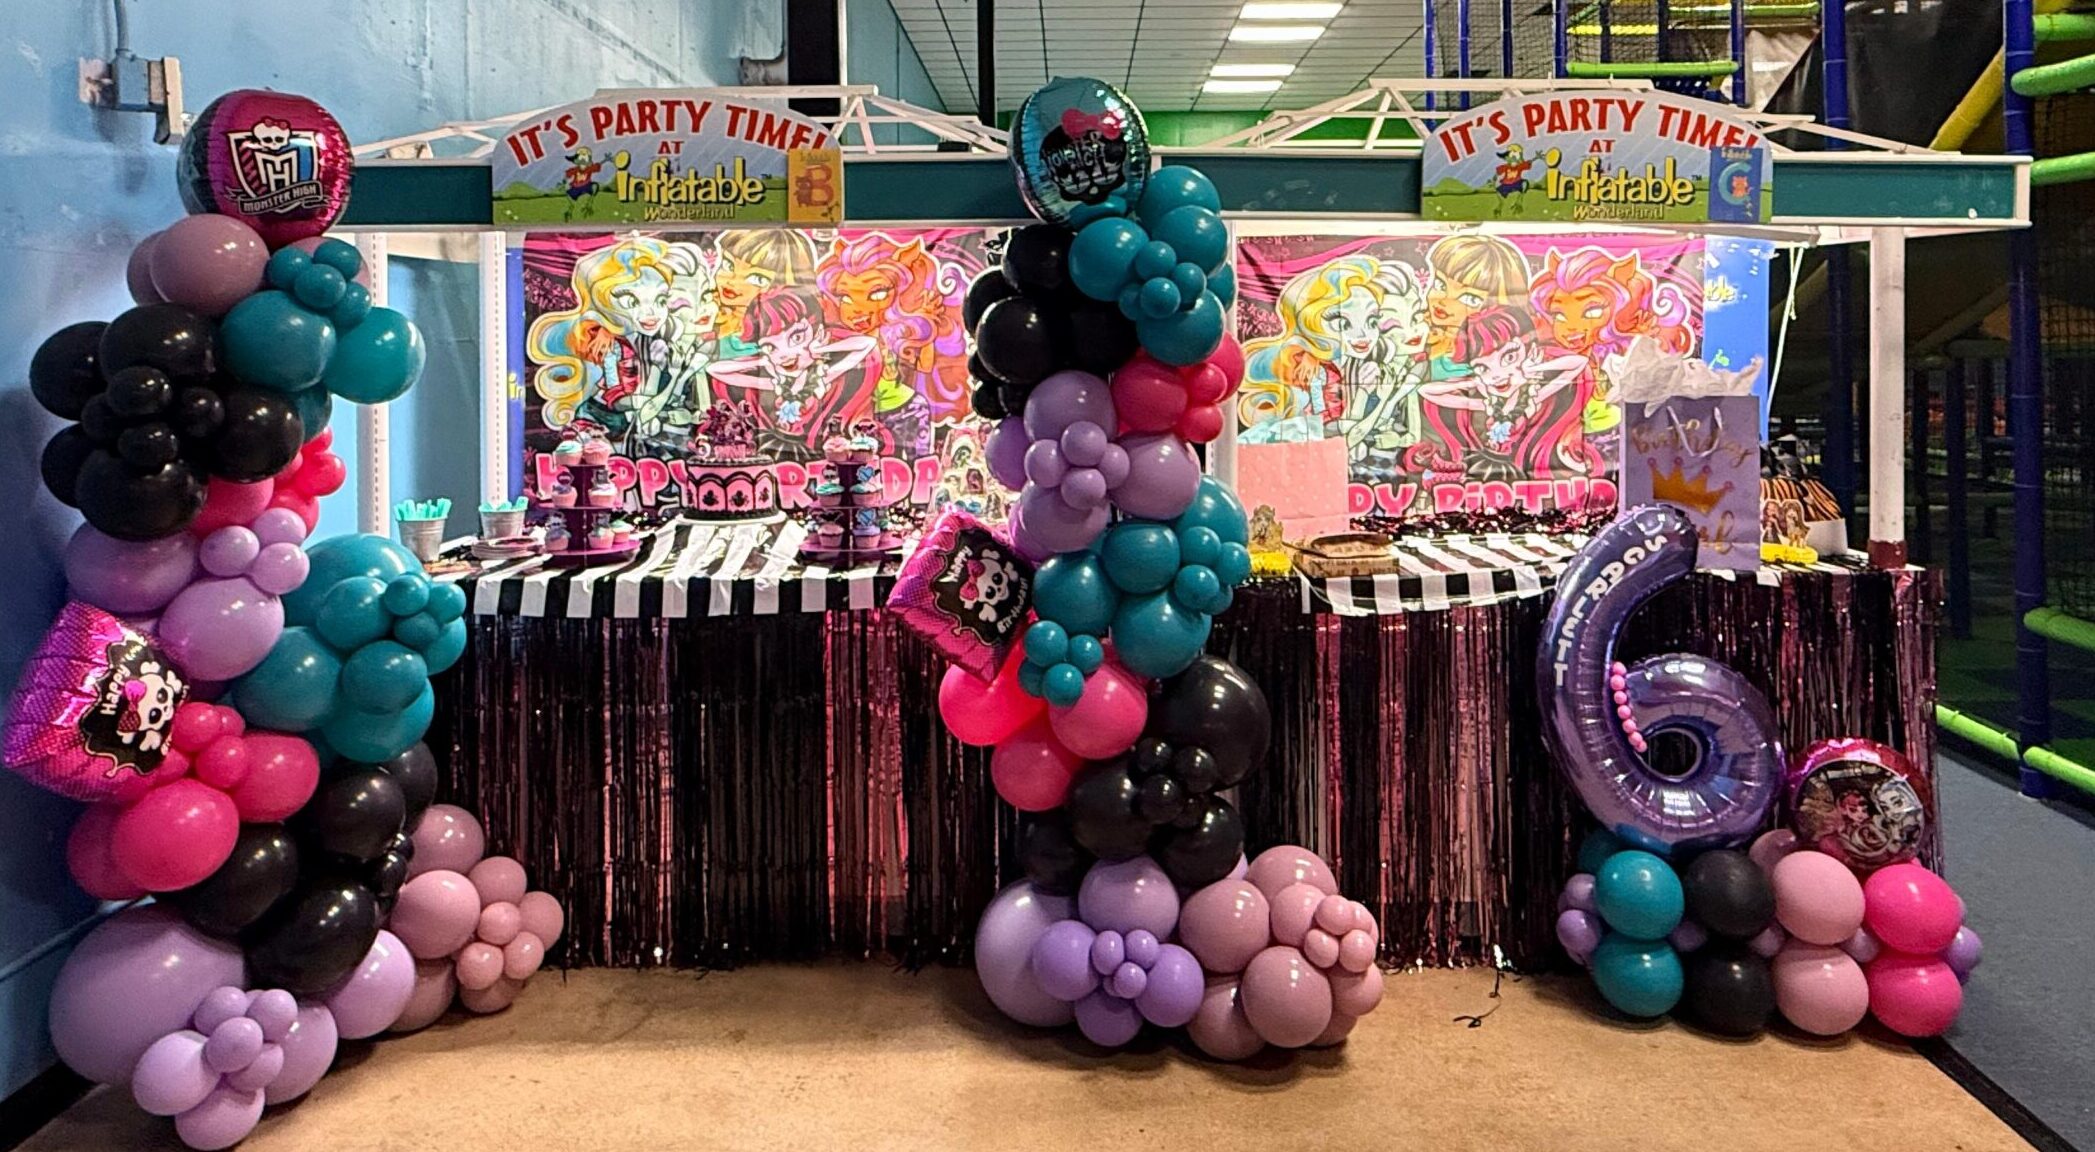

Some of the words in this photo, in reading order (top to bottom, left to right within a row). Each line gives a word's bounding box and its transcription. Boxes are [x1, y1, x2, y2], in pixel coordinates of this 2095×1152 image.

[507, 113, 579, 167] IT'S
[590, 99, 712, 141] PARTY
[726, 103, 829, 151] TIME!
[657, 141, 685, 155] AT
[1439, 110, 1511, 163] IT'S
[1522, 98, 1645, 138] PARTY
[1657, 103, 1760, 150] TIME!
[1588, 139, 1616, 153] AT
[243, 191, 292, 212] MONSTER
[292, 184, 318, 199] HIGH
[614, 150, 766, 206] inflatable
[1544, 147, 1696, 206] inflatable
[643, 203, 735, 221] Wonderland
[1573, 204, 1665, 221] Wonderland
[939, 546, 973, 583] Happy
[1554, 535, 1669, 687] SCARLETT
[100, 664, 131, 716] Happy
